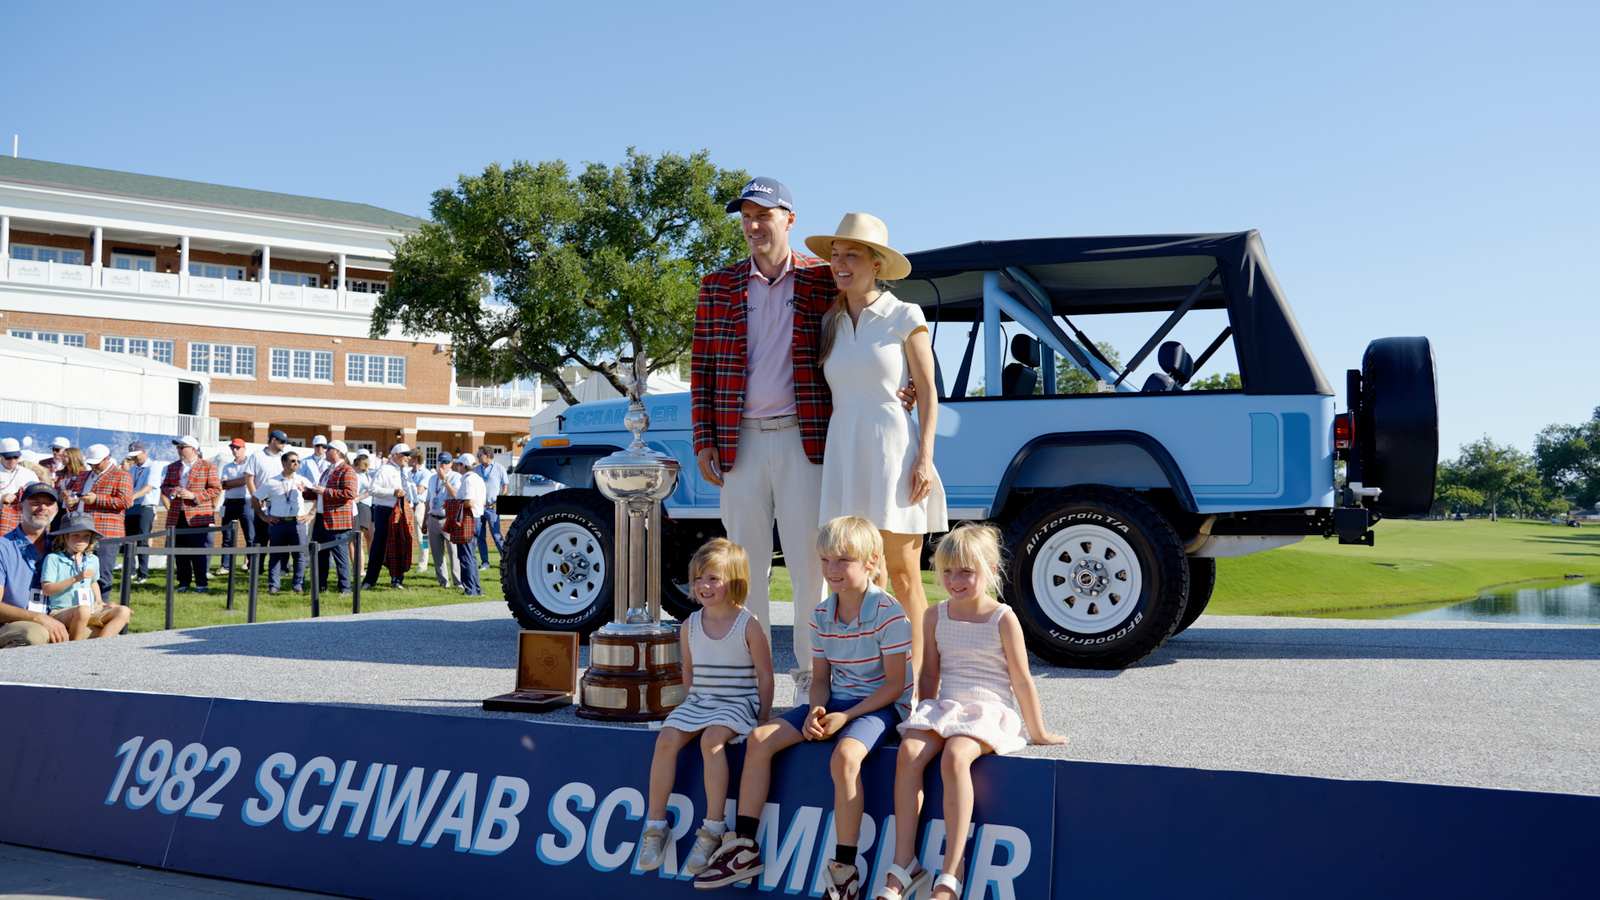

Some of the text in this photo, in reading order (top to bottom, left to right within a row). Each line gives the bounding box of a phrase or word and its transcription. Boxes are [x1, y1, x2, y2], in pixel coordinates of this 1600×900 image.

[573, 405, 678, 426] SCRAMER
[1026, 512, 1130, 555] All-Terrain T/A
[1049, 611, 1144, 646] BFGoodrich
[104, 735, 1032, 900] 1982 SCHWAB SCRMBR
